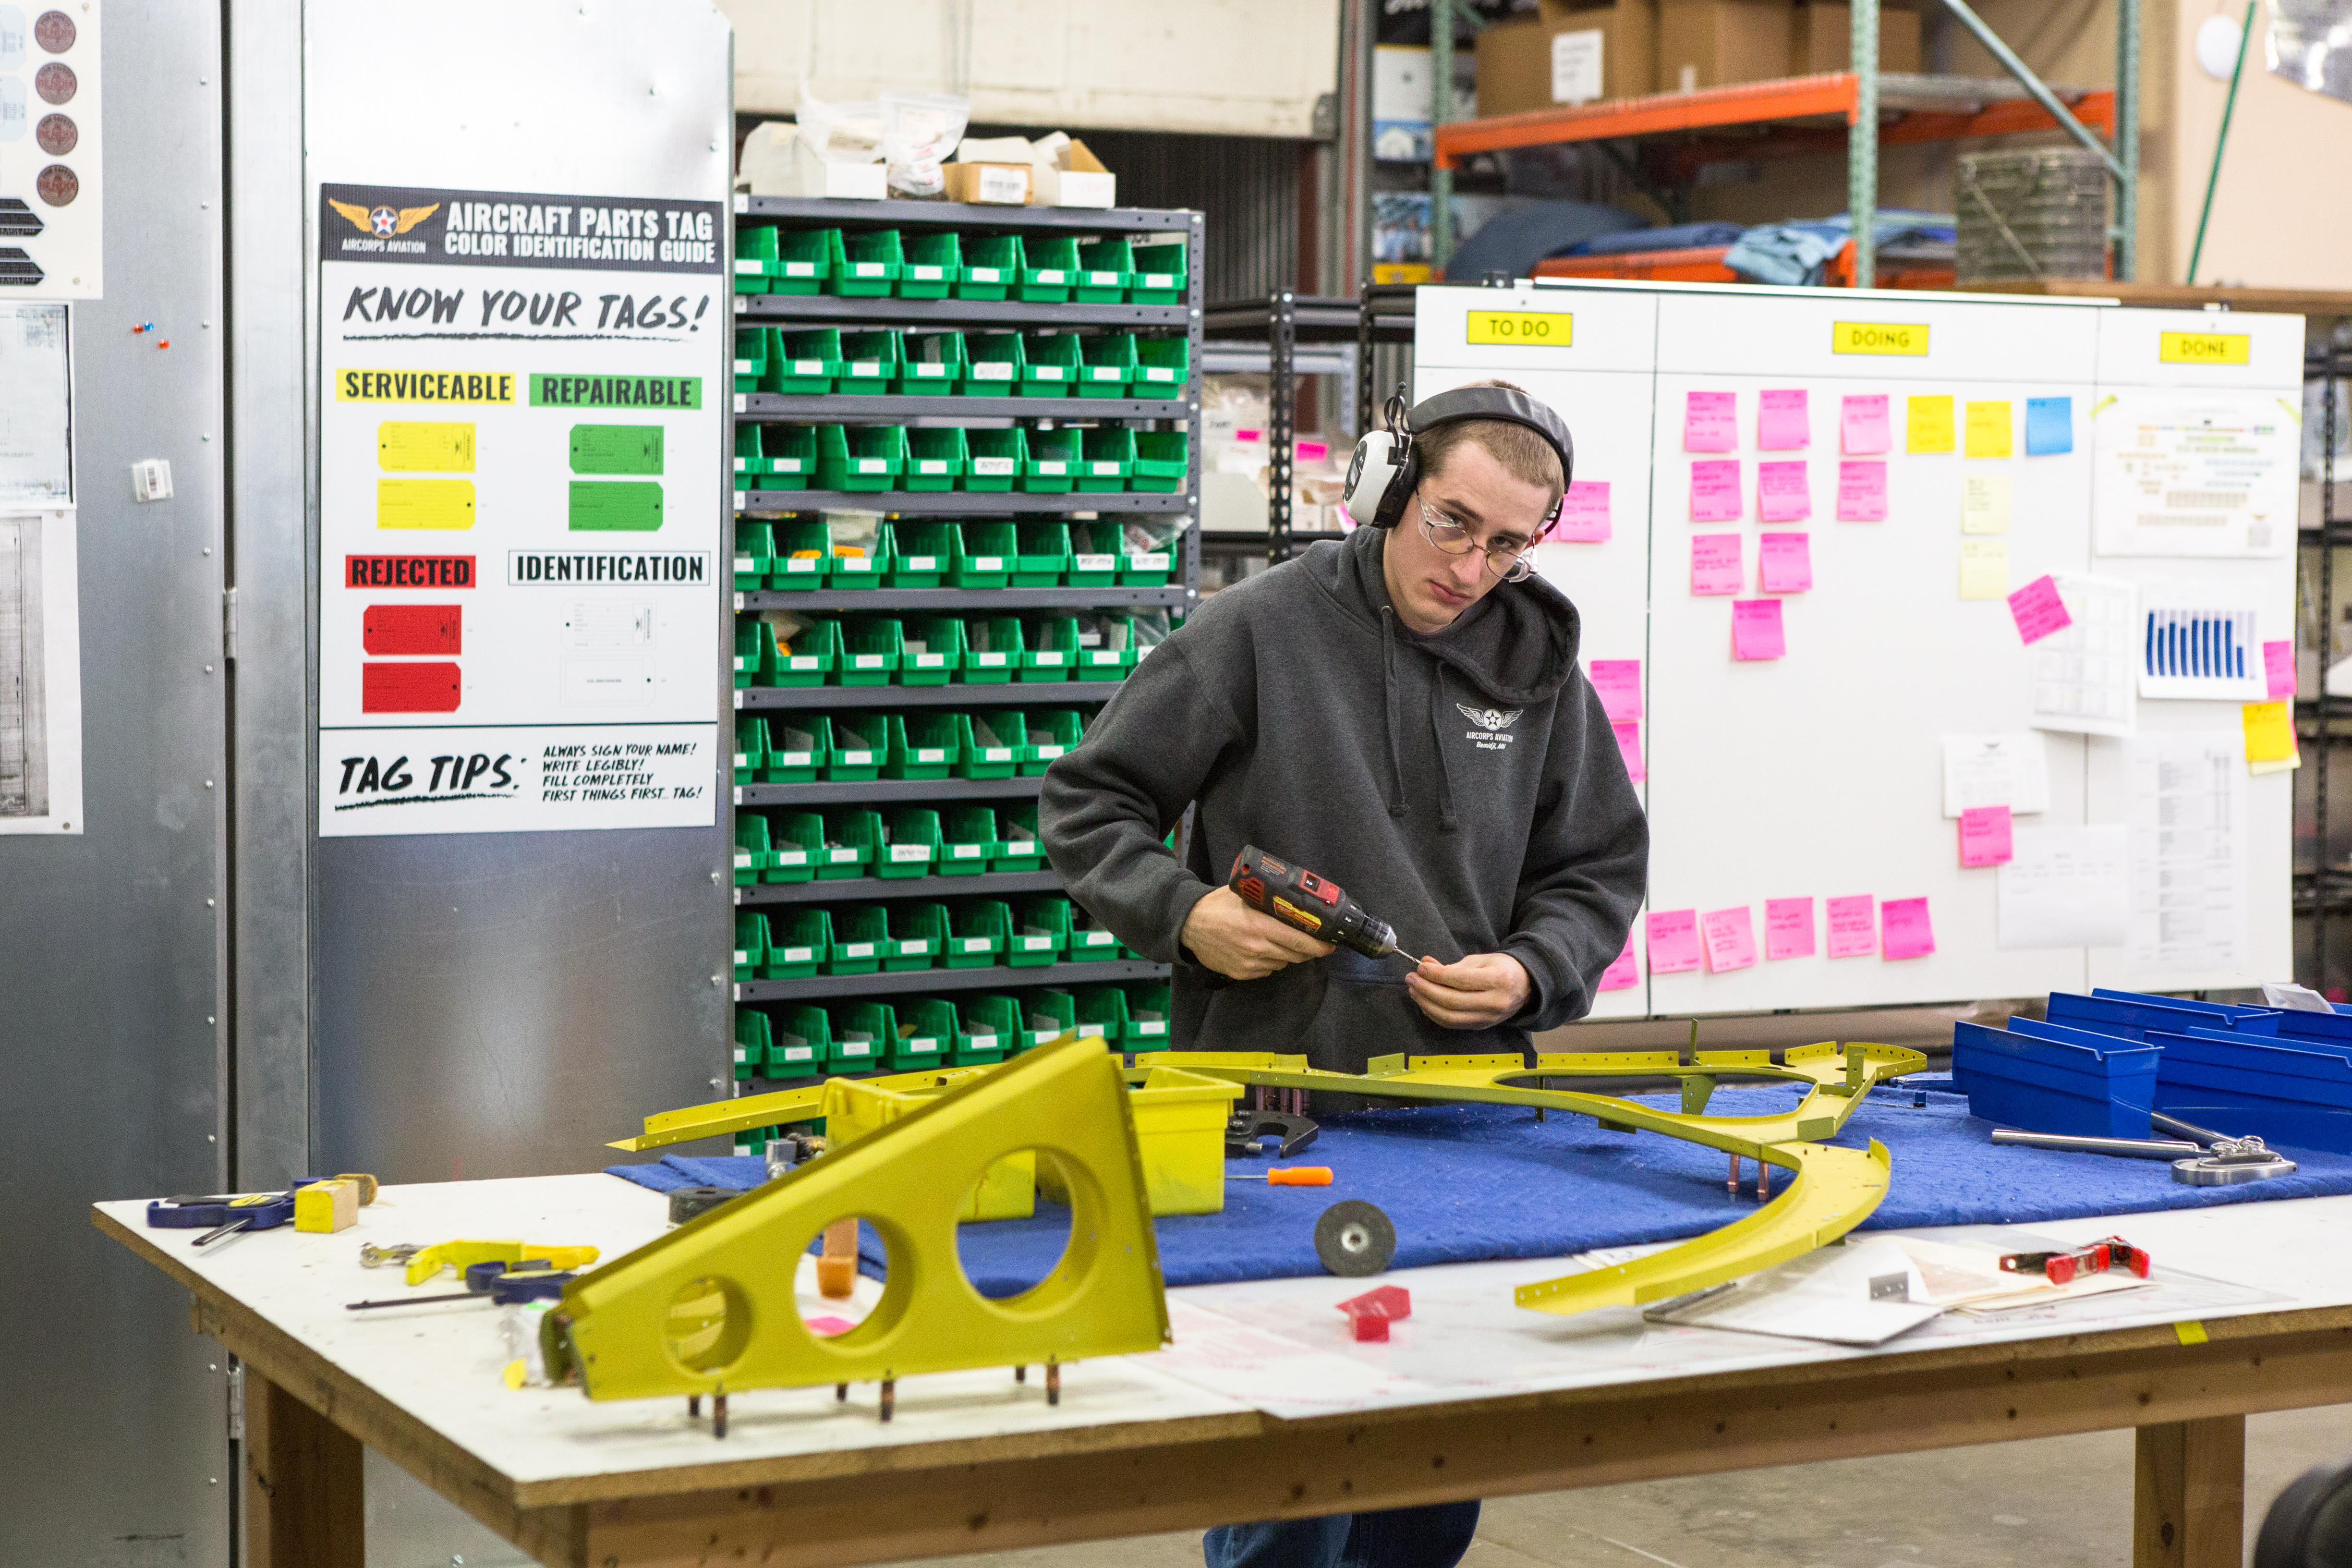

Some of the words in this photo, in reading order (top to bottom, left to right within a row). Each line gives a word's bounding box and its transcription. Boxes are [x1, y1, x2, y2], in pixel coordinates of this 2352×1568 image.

[446, 202, 572, 234] AIRCRAFT
[580, 207, 659, 239] PARTS
[665, 211, 713, 241] TAG
[342, 238, 385, 253] AIRCORPS
[387, 240, 426, 254] AVIATION
[445, 233, 508, 256] COLOR
[513, 235, 655, 262] IDENTIFICATION
[660, 240, 715, 264] GUIDE
[343, 287, 464, 324] KNOW
[481, 290, 582, 327] YOUR
[598, 293, 710, 332] TAGS!
[1490, 320, 1514, 336] TO
[1523, 321, 1550, 337] DO
[1852, 328, 1910, 347] DOING
[2182, 339, 2229, 356] DONE
[345, 372, 511, 401] SERVICEABLE
[542, 377, 692, 407] REPAIRABLE
[352, 559, 470, 586] REJECTED
[517, 556, 703, 582] IDENTIFICATION
[1466, 731, 1493, 740] AIRCORPS
[1495, 733, 1513, 742] AVIATION
[543, 744, 586, 758] ALWAYS
[591, 744, 623, 757] SIGN
[626, 744, 653, 756] YOUR
[655, 743, 697, 756] NAME!
[339, 756, 413, 794] TAG
[428, 754, 527, 792] TIPS:
[543, 760, 581, 773] WRITE
[586, 758, 645, 772] LEGIBLY!
[543, 775, 568, 787] FILL
[573, 772, 654, 786] COMPLETELY
[543, 789, 578, 802] FIRST
[582, 789, 626, 802] THINGS
[673, 786, 703, 800] TAG!
